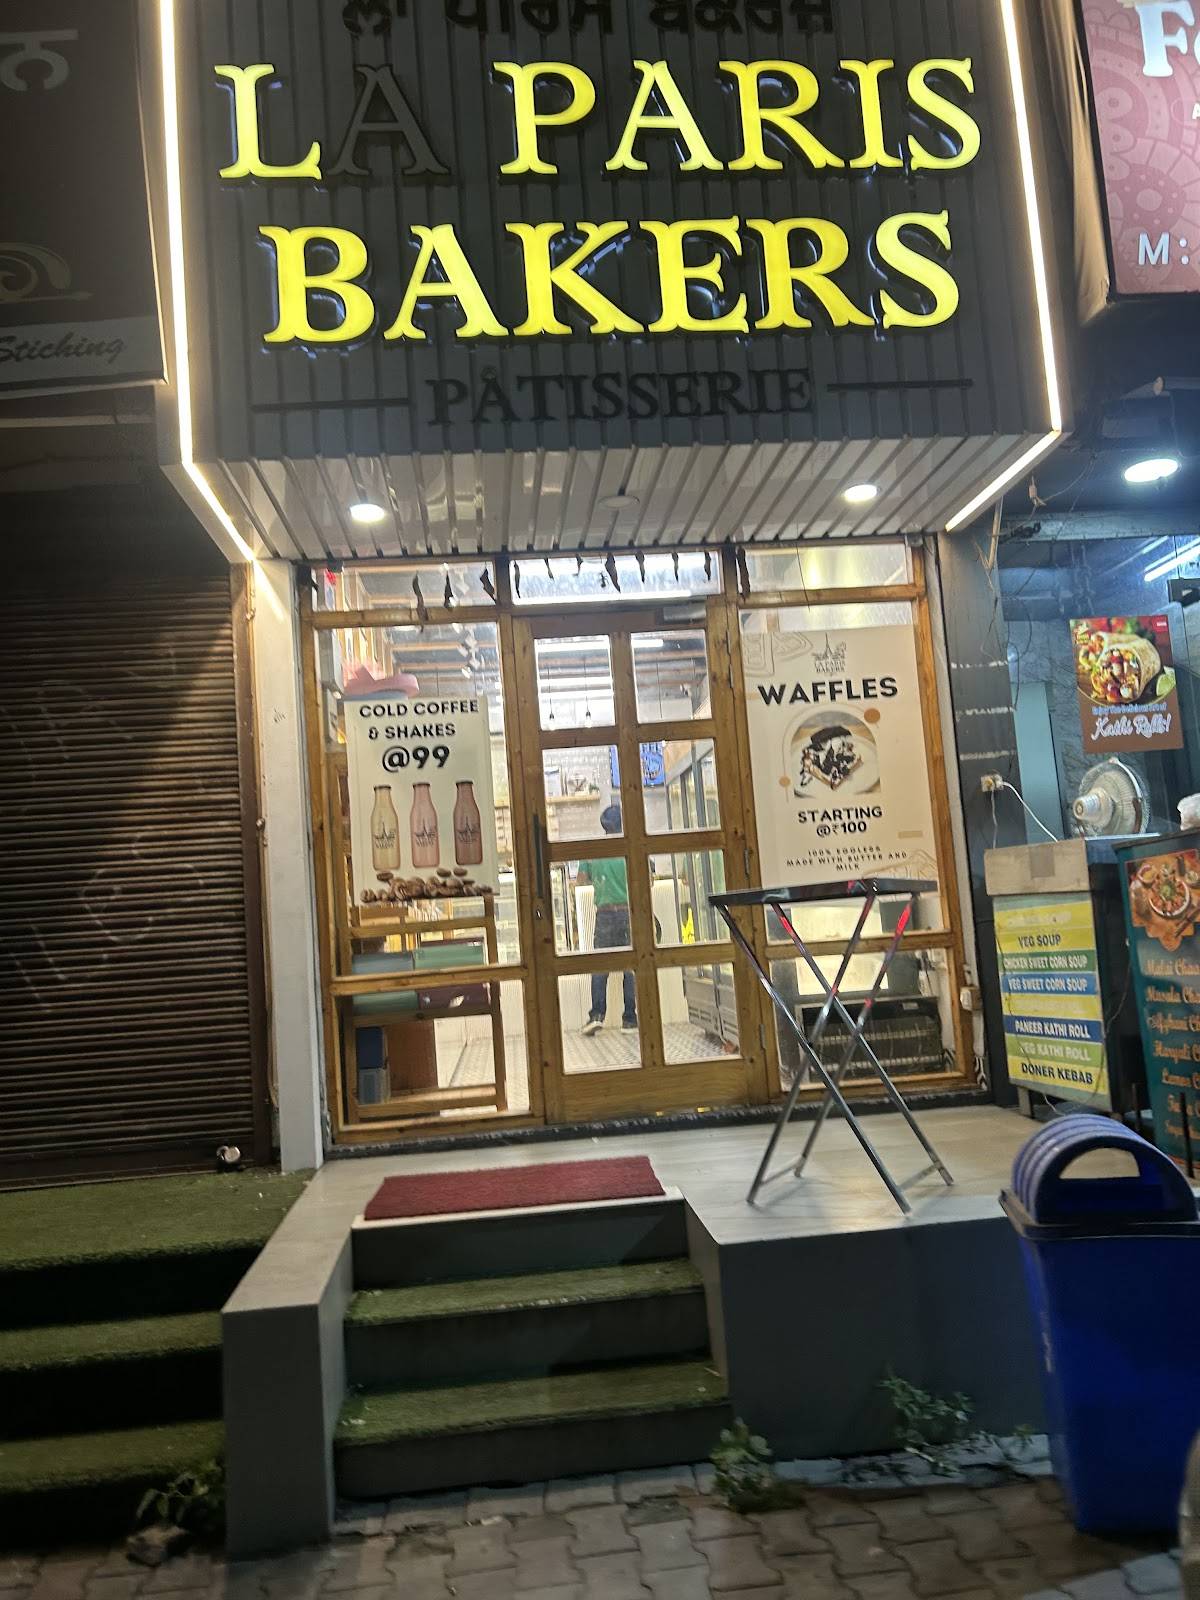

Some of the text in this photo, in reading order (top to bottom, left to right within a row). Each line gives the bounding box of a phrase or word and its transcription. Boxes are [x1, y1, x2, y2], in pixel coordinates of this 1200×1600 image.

[214, 57, 982, 180] LA PARIS
[258, 209, 960, 344] BAKERS
[757, 677, 898, 706] WAFFLES
[360, 699, 479, 718] COLD COFFEE
[368, 722, 456, 740] & SHAKES
[382, 745, 450, 773] @99
[798, 806, 883, 824] STARTING
[816, 820, 867, 838] @₹100
[786, 851, 907, 867] MADE WITH BUTTER AND
[836, 864, 860, 872] MILK
[1018, 933, 1061, 949] VEG SOUP
[1028, 956, 1048, 969] SWEET
[1049, 955, 1068, 969] CORN
[1068, 954, 1088, 969] SOUP
[1008, 977, 1088, 992] VEG SWEET CORN SOUP
[1014, 1020, 1091, 1039] PANEER KATHI ROLL
[1037, 1043, 1064, 1058] KATHI
[1065, 1046, 1091, 1061] ROLL
[1021, 1062, 1093, 1085] DONER KEBAB
